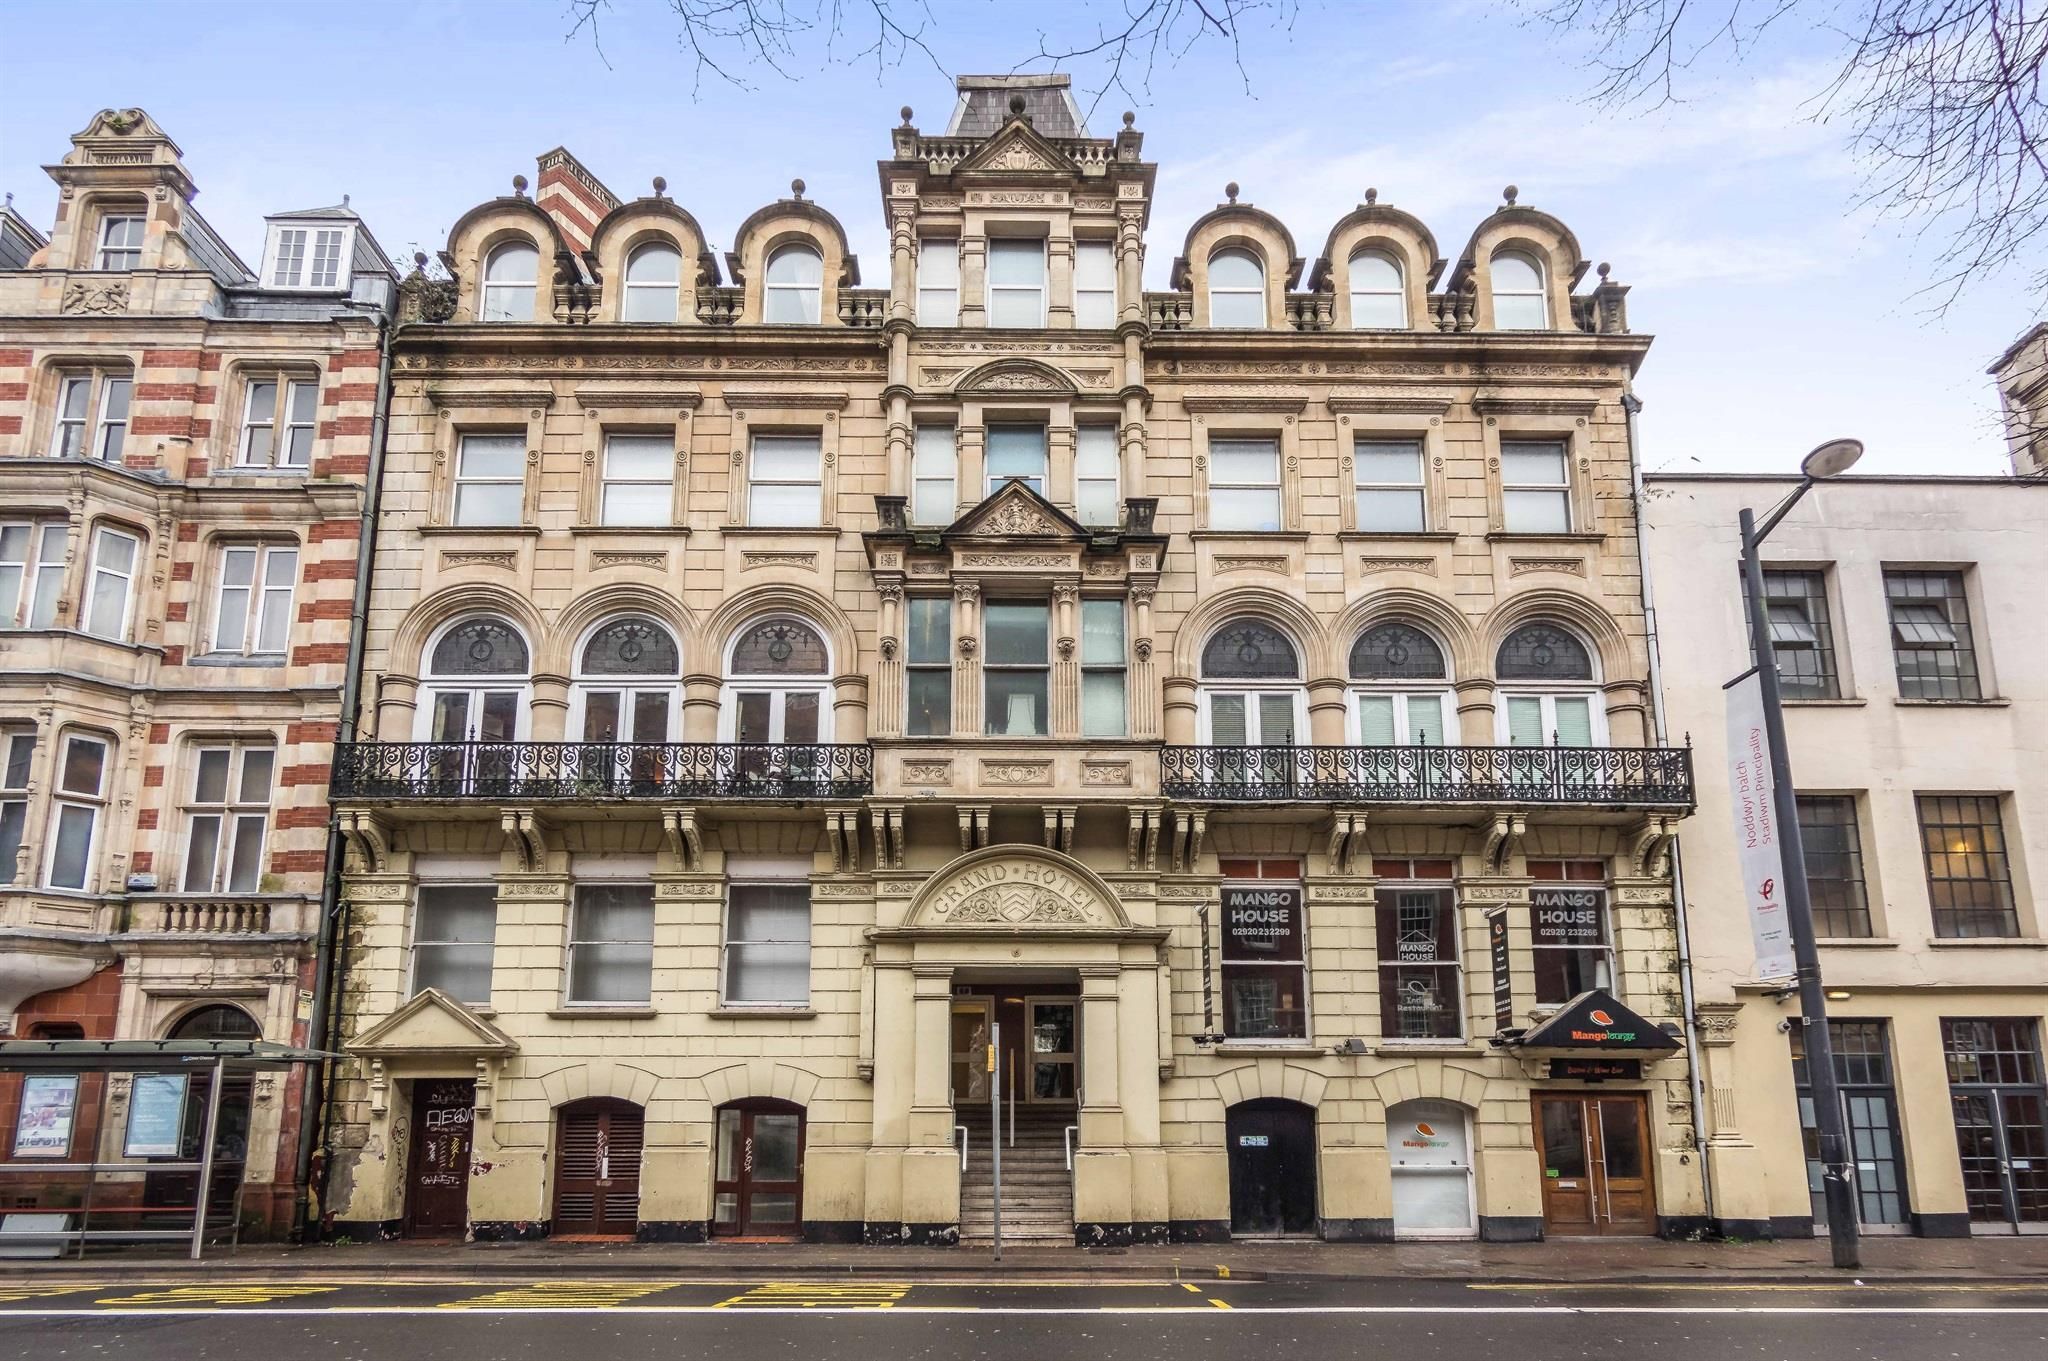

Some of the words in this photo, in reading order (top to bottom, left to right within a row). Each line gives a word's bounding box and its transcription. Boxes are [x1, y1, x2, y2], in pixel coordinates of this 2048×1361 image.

[1749, 727, 1764, 792] Principality
[1736, 761, 1749, 793] balch
[1742, 796, 1757, 849] Noddwyr
[1759, 793, 1771, 845] Stadiwm
[935, 864, 1007, 913] GRAND
[1023, 864, 1097, 918] HOTEL
[1230, 892, 1291, 906] MANGO
[1535, 893, 1596, 906] MANGO
[1231, 909, 1289, 923] HOUSE
[1540, 910, 1596, 924] HOUSE
[1400, 944, 1434, 952] MANGO
[1401, 953, 1434, 961] HOUSE
